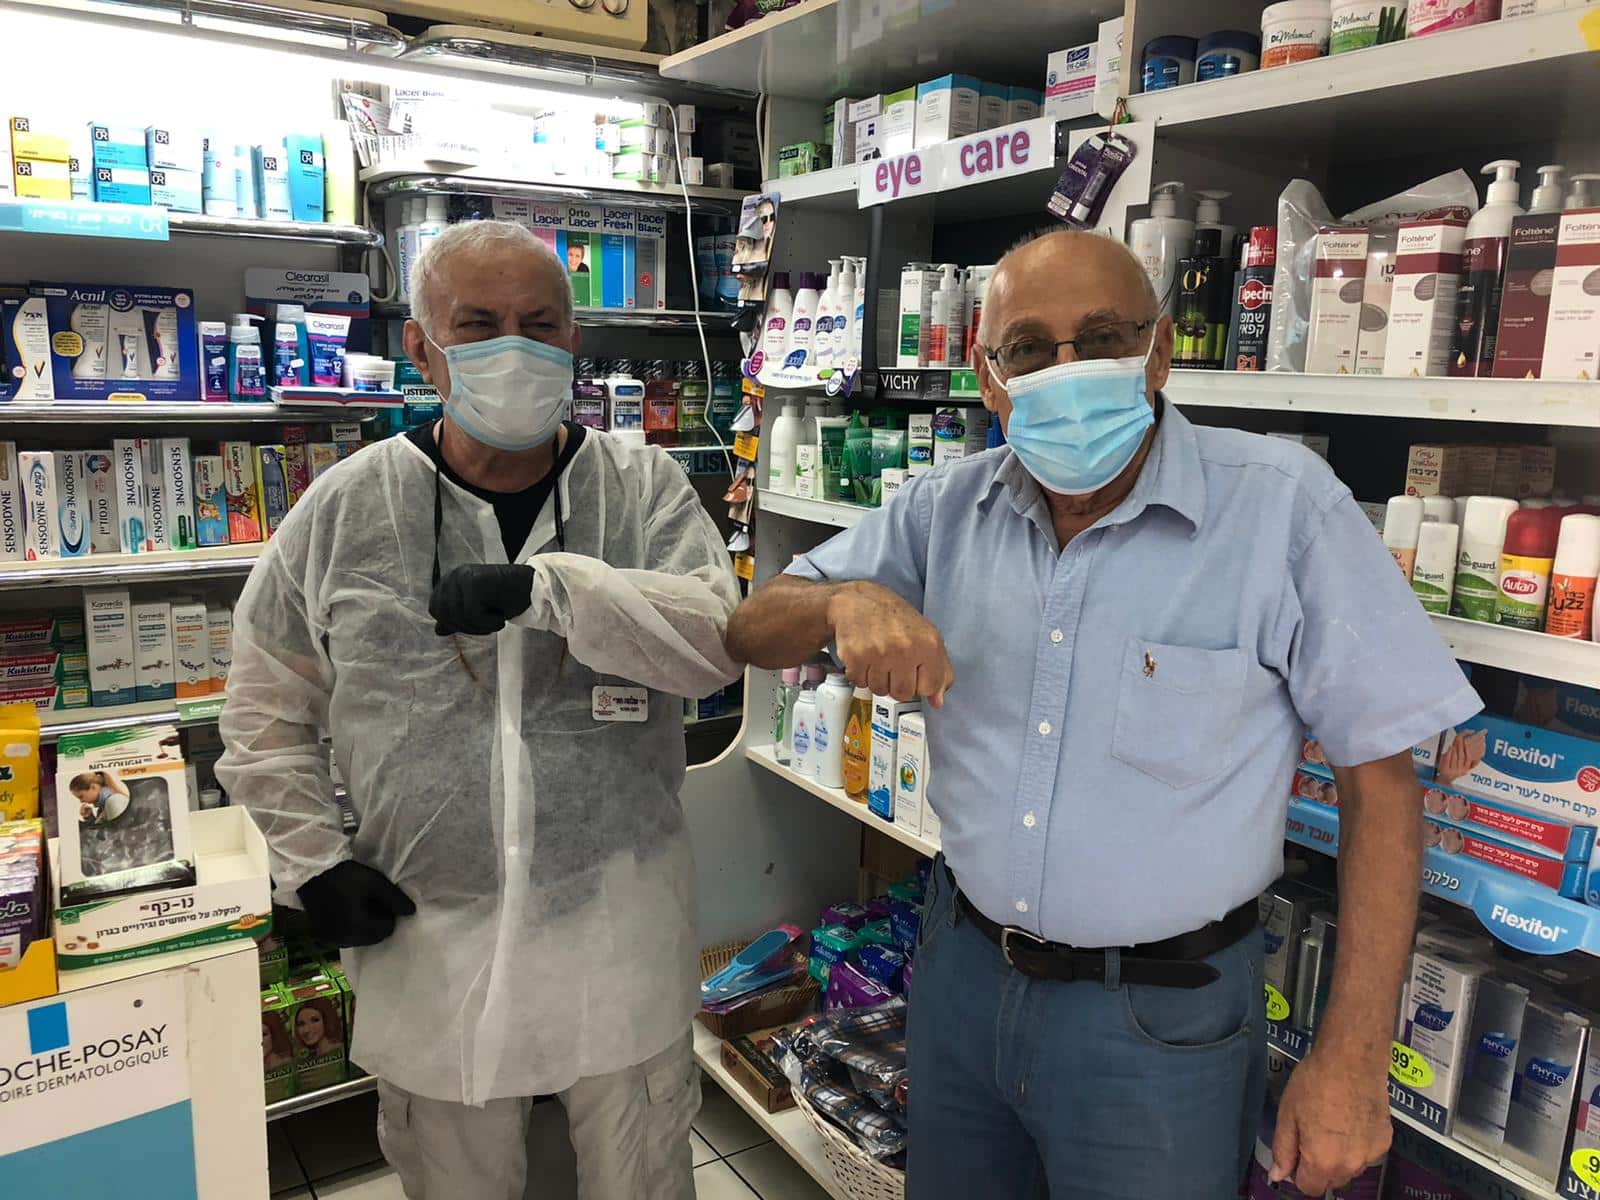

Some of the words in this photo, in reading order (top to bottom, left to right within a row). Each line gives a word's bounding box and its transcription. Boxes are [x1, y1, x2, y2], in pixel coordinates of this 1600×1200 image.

[875, 155, 922, 198] eye
[960, 131, 1031, 177] care
[533, 213, 565, 225] Lacer
[568, 207, 591, 217] Orto
[603, 207, 633, 220] Lacer
[638, 211, 665, 224] Lacer
[568, 217, 600, 228] Lacer
[603, 219, 633, 230] Fresh
[638, 223, 663, 234] Blanc
[285, 271, 330, 283] Clearasil
[71, 289, 105, 302] Acnil
[312, 320, 345, 331] Clearasil
[880, 375, 920, 391] VICHY
[403, 388, 438, 396] LISTERIN
[232, 446, 241, 469] Lacer
[123, 446, 136, 507] SENSODYNE
[171, 446, 185, 507] SENSODYNE
[202, 460, 212, 483] Lacer
[34, 471, 43, 496] RAPID
[64, 454, 76, 508] SENSODYNE
[1, 490, 16, 553] SENSODYNE
[152, 486, 164, 544] SENSODYNE
[36, 500, 48, 555] SENSODYNE
[1503, 579, 1535, 593] Autan
[7, 664, 52, 676] Kukident
[1470, 772, 1492, 787] מאד
[1495, 779, 1514, 793] יבש
[1514, 784, 1541, 799] לעור
[1543, 793, 1571, 808] ידיים
[1573, 802, 1597, 818] קרם
[1307, 826, 1335, 845] עובד
[0, 901, 31, 920] ola
[199, 911, 210, 920] על
[212, 905, 241, 918] להקלה
[121, 921, 157, 935] וגירויים
[158, 914, 197, 928] מיחושים
[96, 926, 120, 939] בגרון
[1419, 1008, 1448, 1029] PHYTO
[1282, 1029, 1302, 1049] זוג
[1482, 1036, 1513, 1057] PHYTO
[0, 1023, 168, 1088] OCHE-POSAY
[0, 1083, 33, 1104] OIRE
[37, 1045, 169, 1094] DERMATOLOGIQUE
[1411, 1065, 1424, 1078] רק
[1531, 1062, 1566, 1085] PHYTO
[1420, 1101, 1442, 1125] זוג
